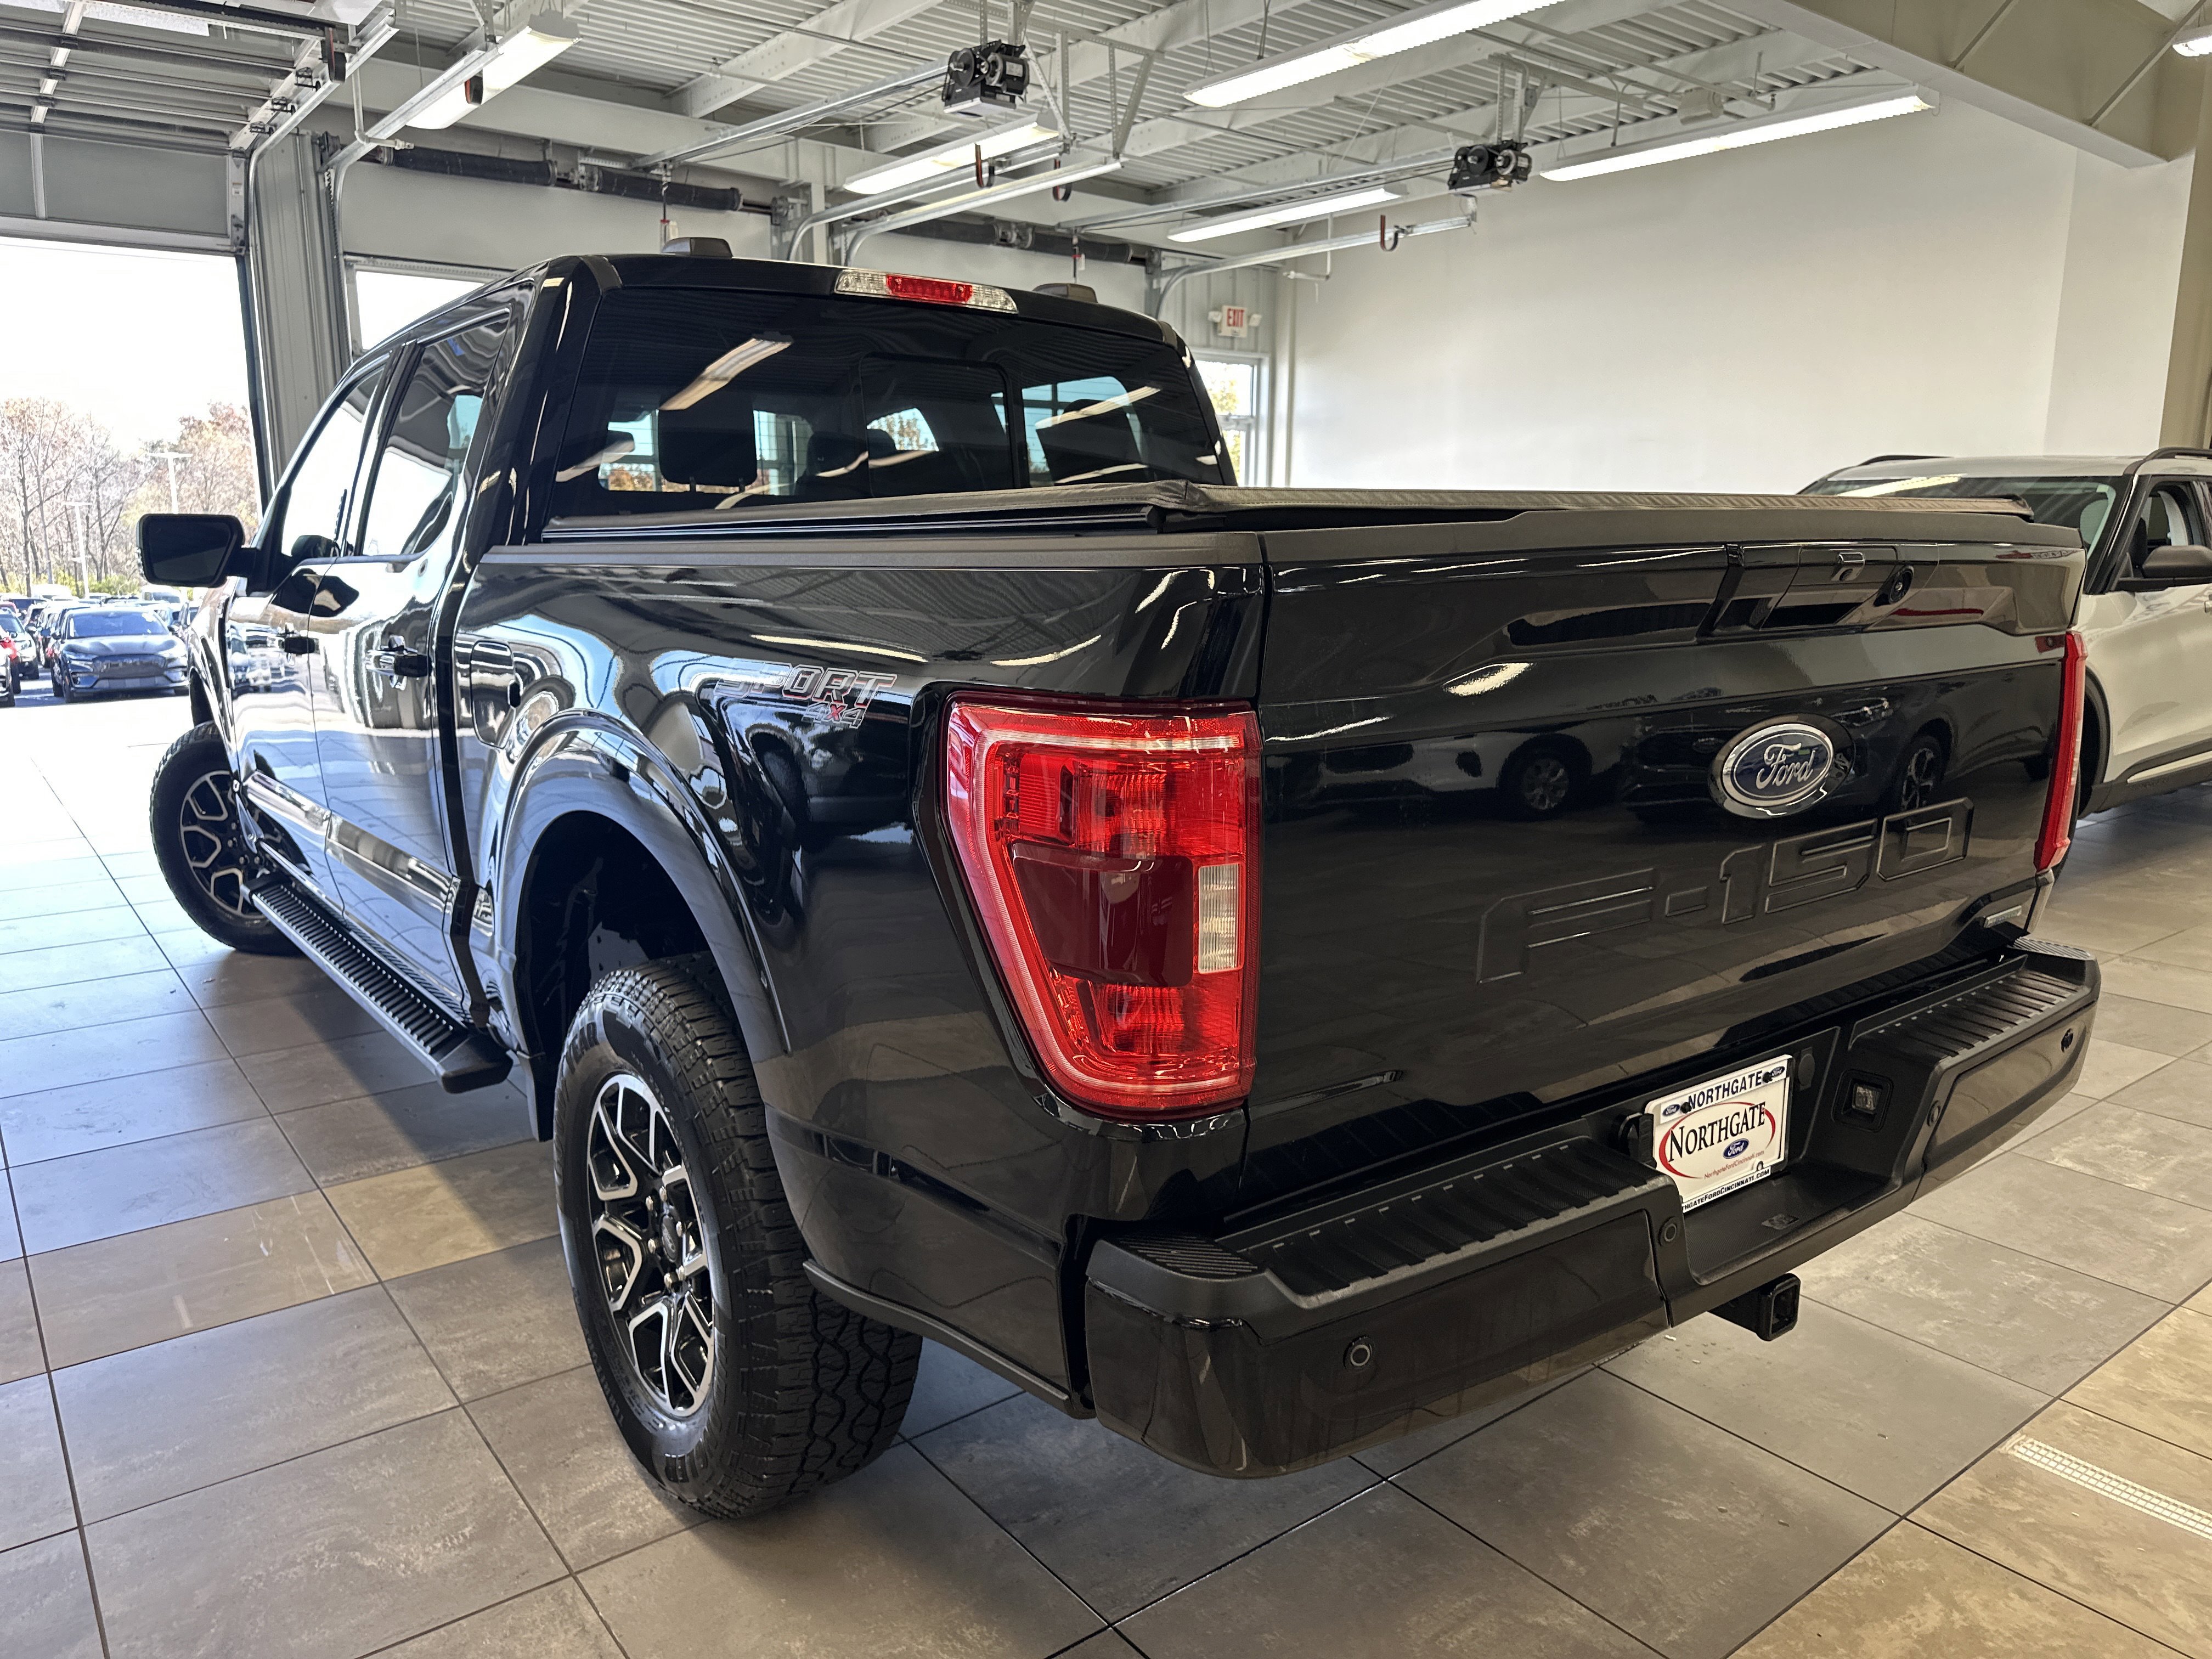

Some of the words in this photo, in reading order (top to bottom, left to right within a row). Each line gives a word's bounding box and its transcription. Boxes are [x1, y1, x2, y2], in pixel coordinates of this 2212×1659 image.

[1227, 308, 1245, 326] EXIT
[1756, 742, 1816, 789] Ford
[1477, 797, 1973, 984] F-150
[1664, 1104, 1679, 1115] Ford
[1688, 1070, 1763, 1110] NORTHGATE
[1668, 1102, 1765, 1163] NORTHGATE
[1726, 1139, 1747, 1156] Ford
